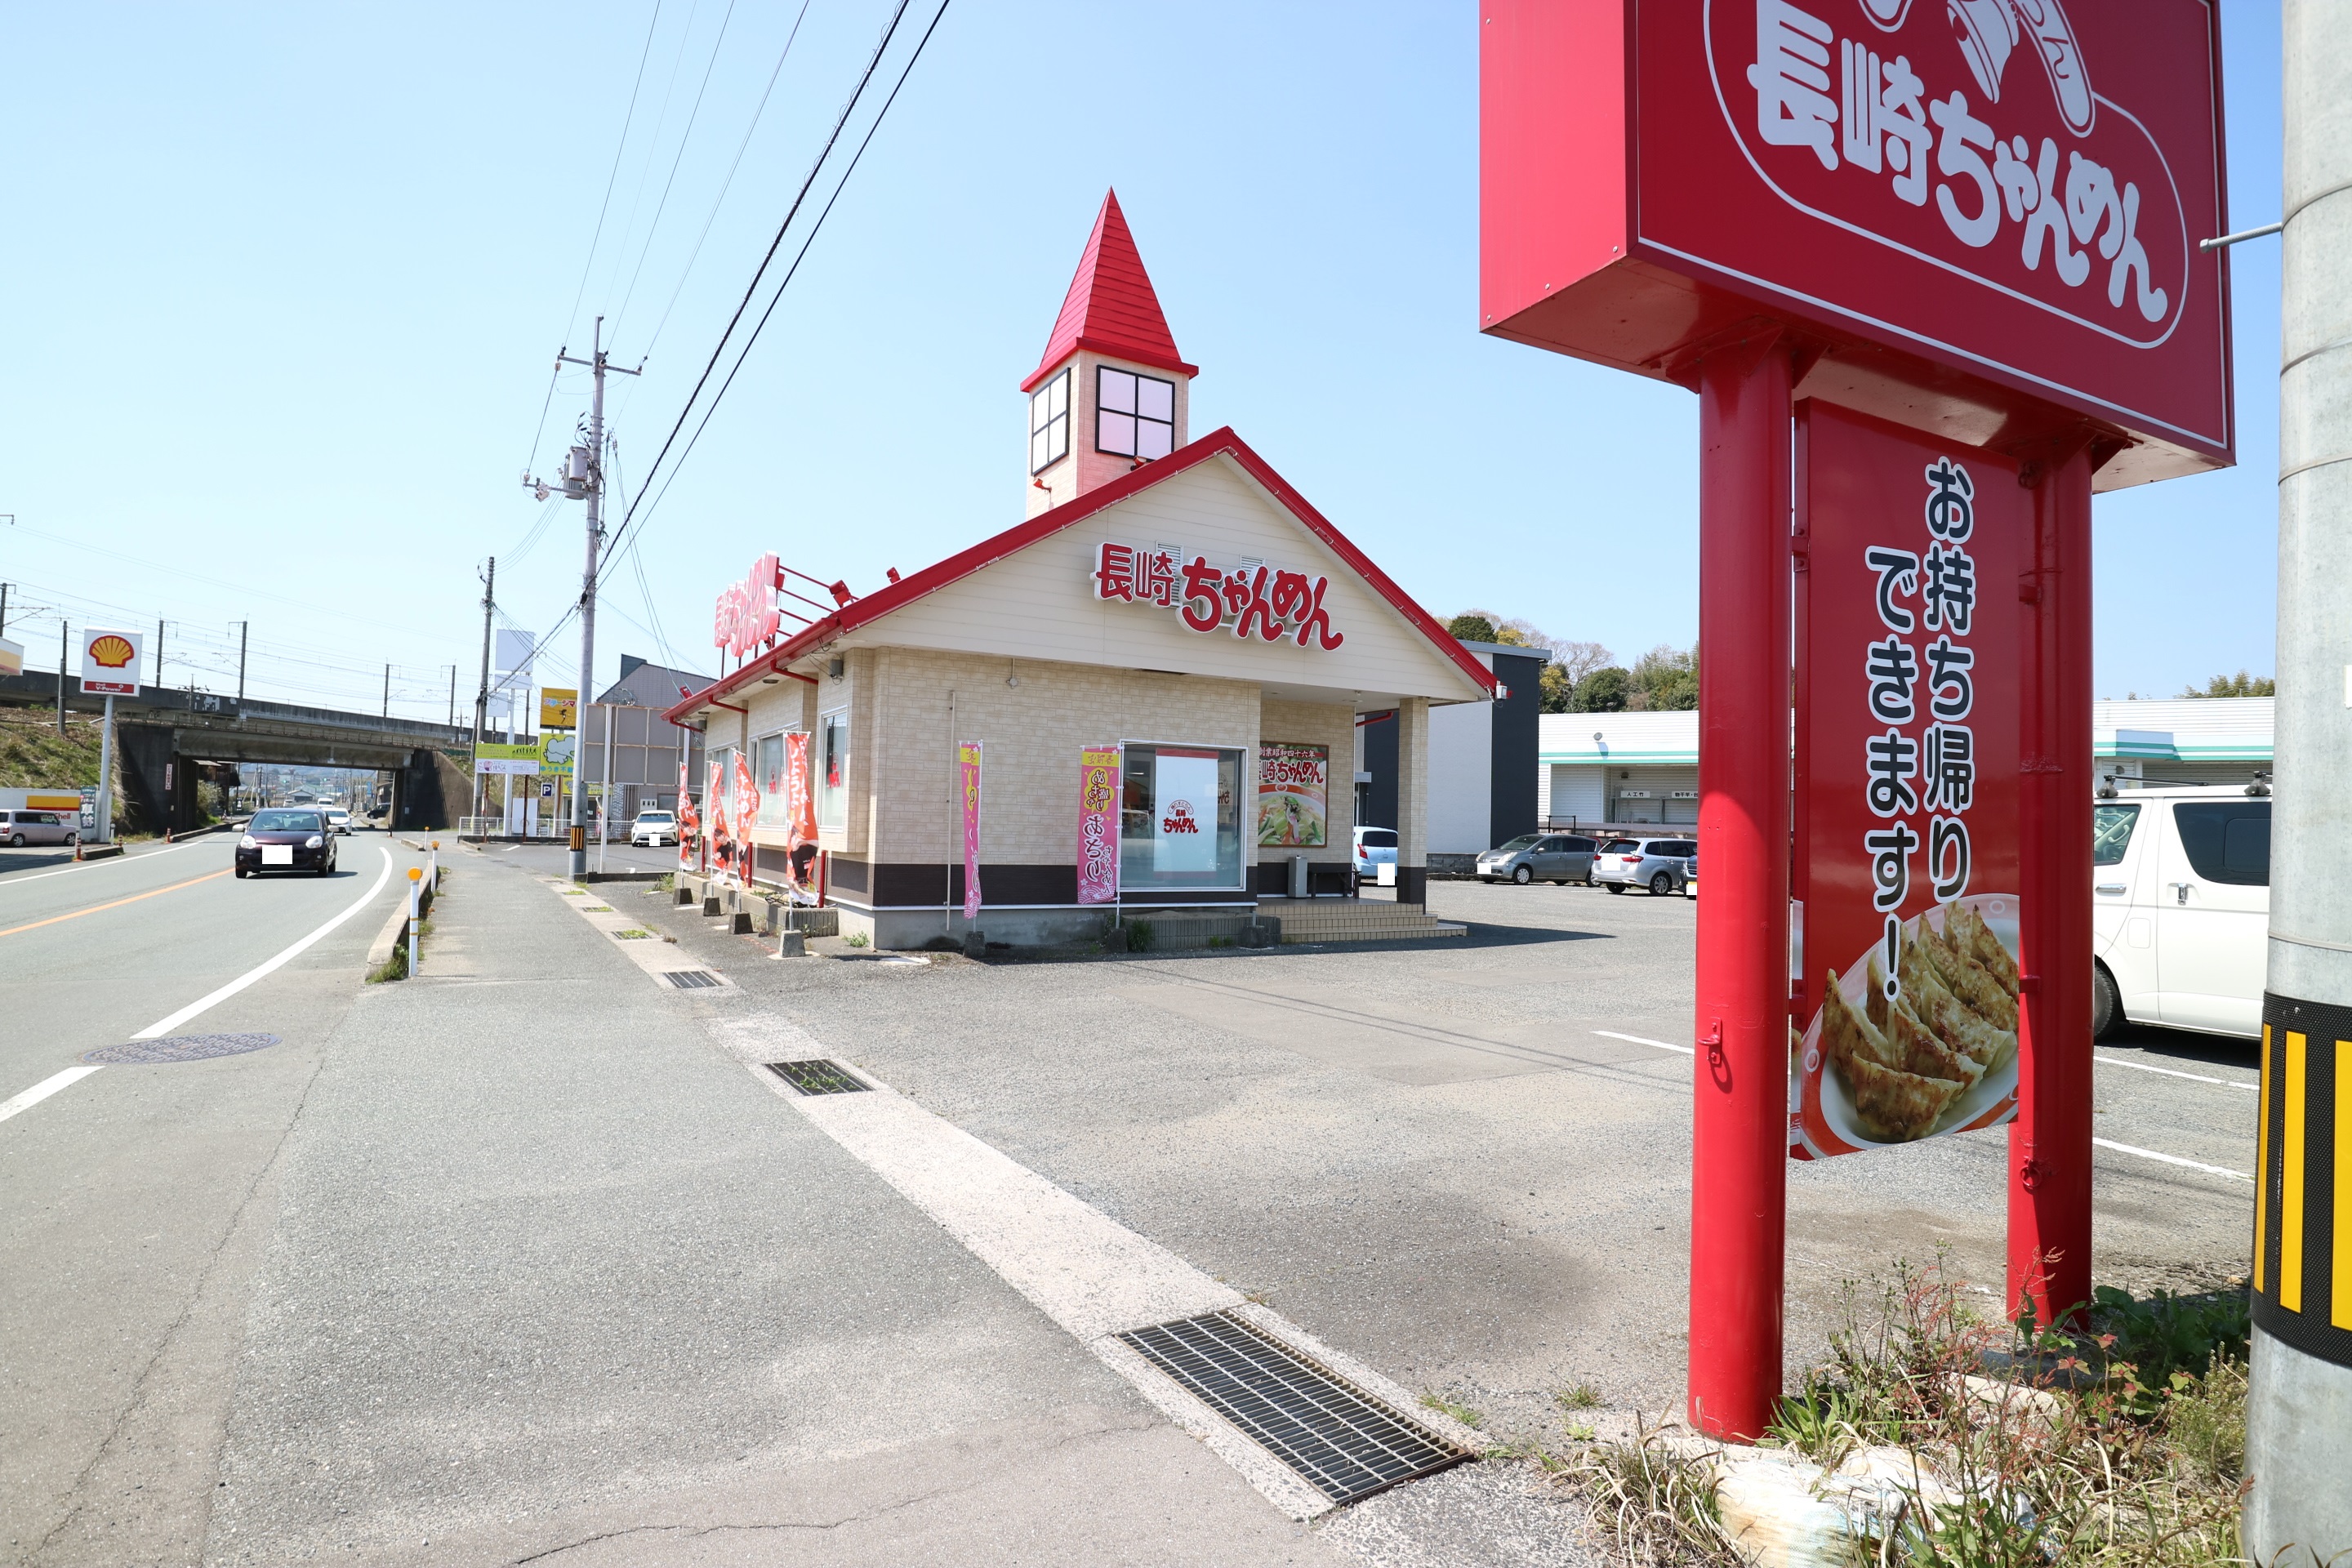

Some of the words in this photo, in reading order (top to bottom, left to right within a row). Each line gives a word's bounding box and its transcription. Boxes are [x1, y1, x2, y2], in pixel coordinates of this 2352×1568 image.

[1747, 0, 2168, 323] 長崎ちゃんめん
[1090, 542, 1345, 652] 長崎ちゃんめん
[1924, 456, 1976, 904] お持ち帰り
[543, 786, 551, 795] P
[1163, 817, 1198, 834] ちゃんめん
[1259, 760, 1324, 784] 崎ちゃんめん
[1865, 545, 1920, 1002] できます！
